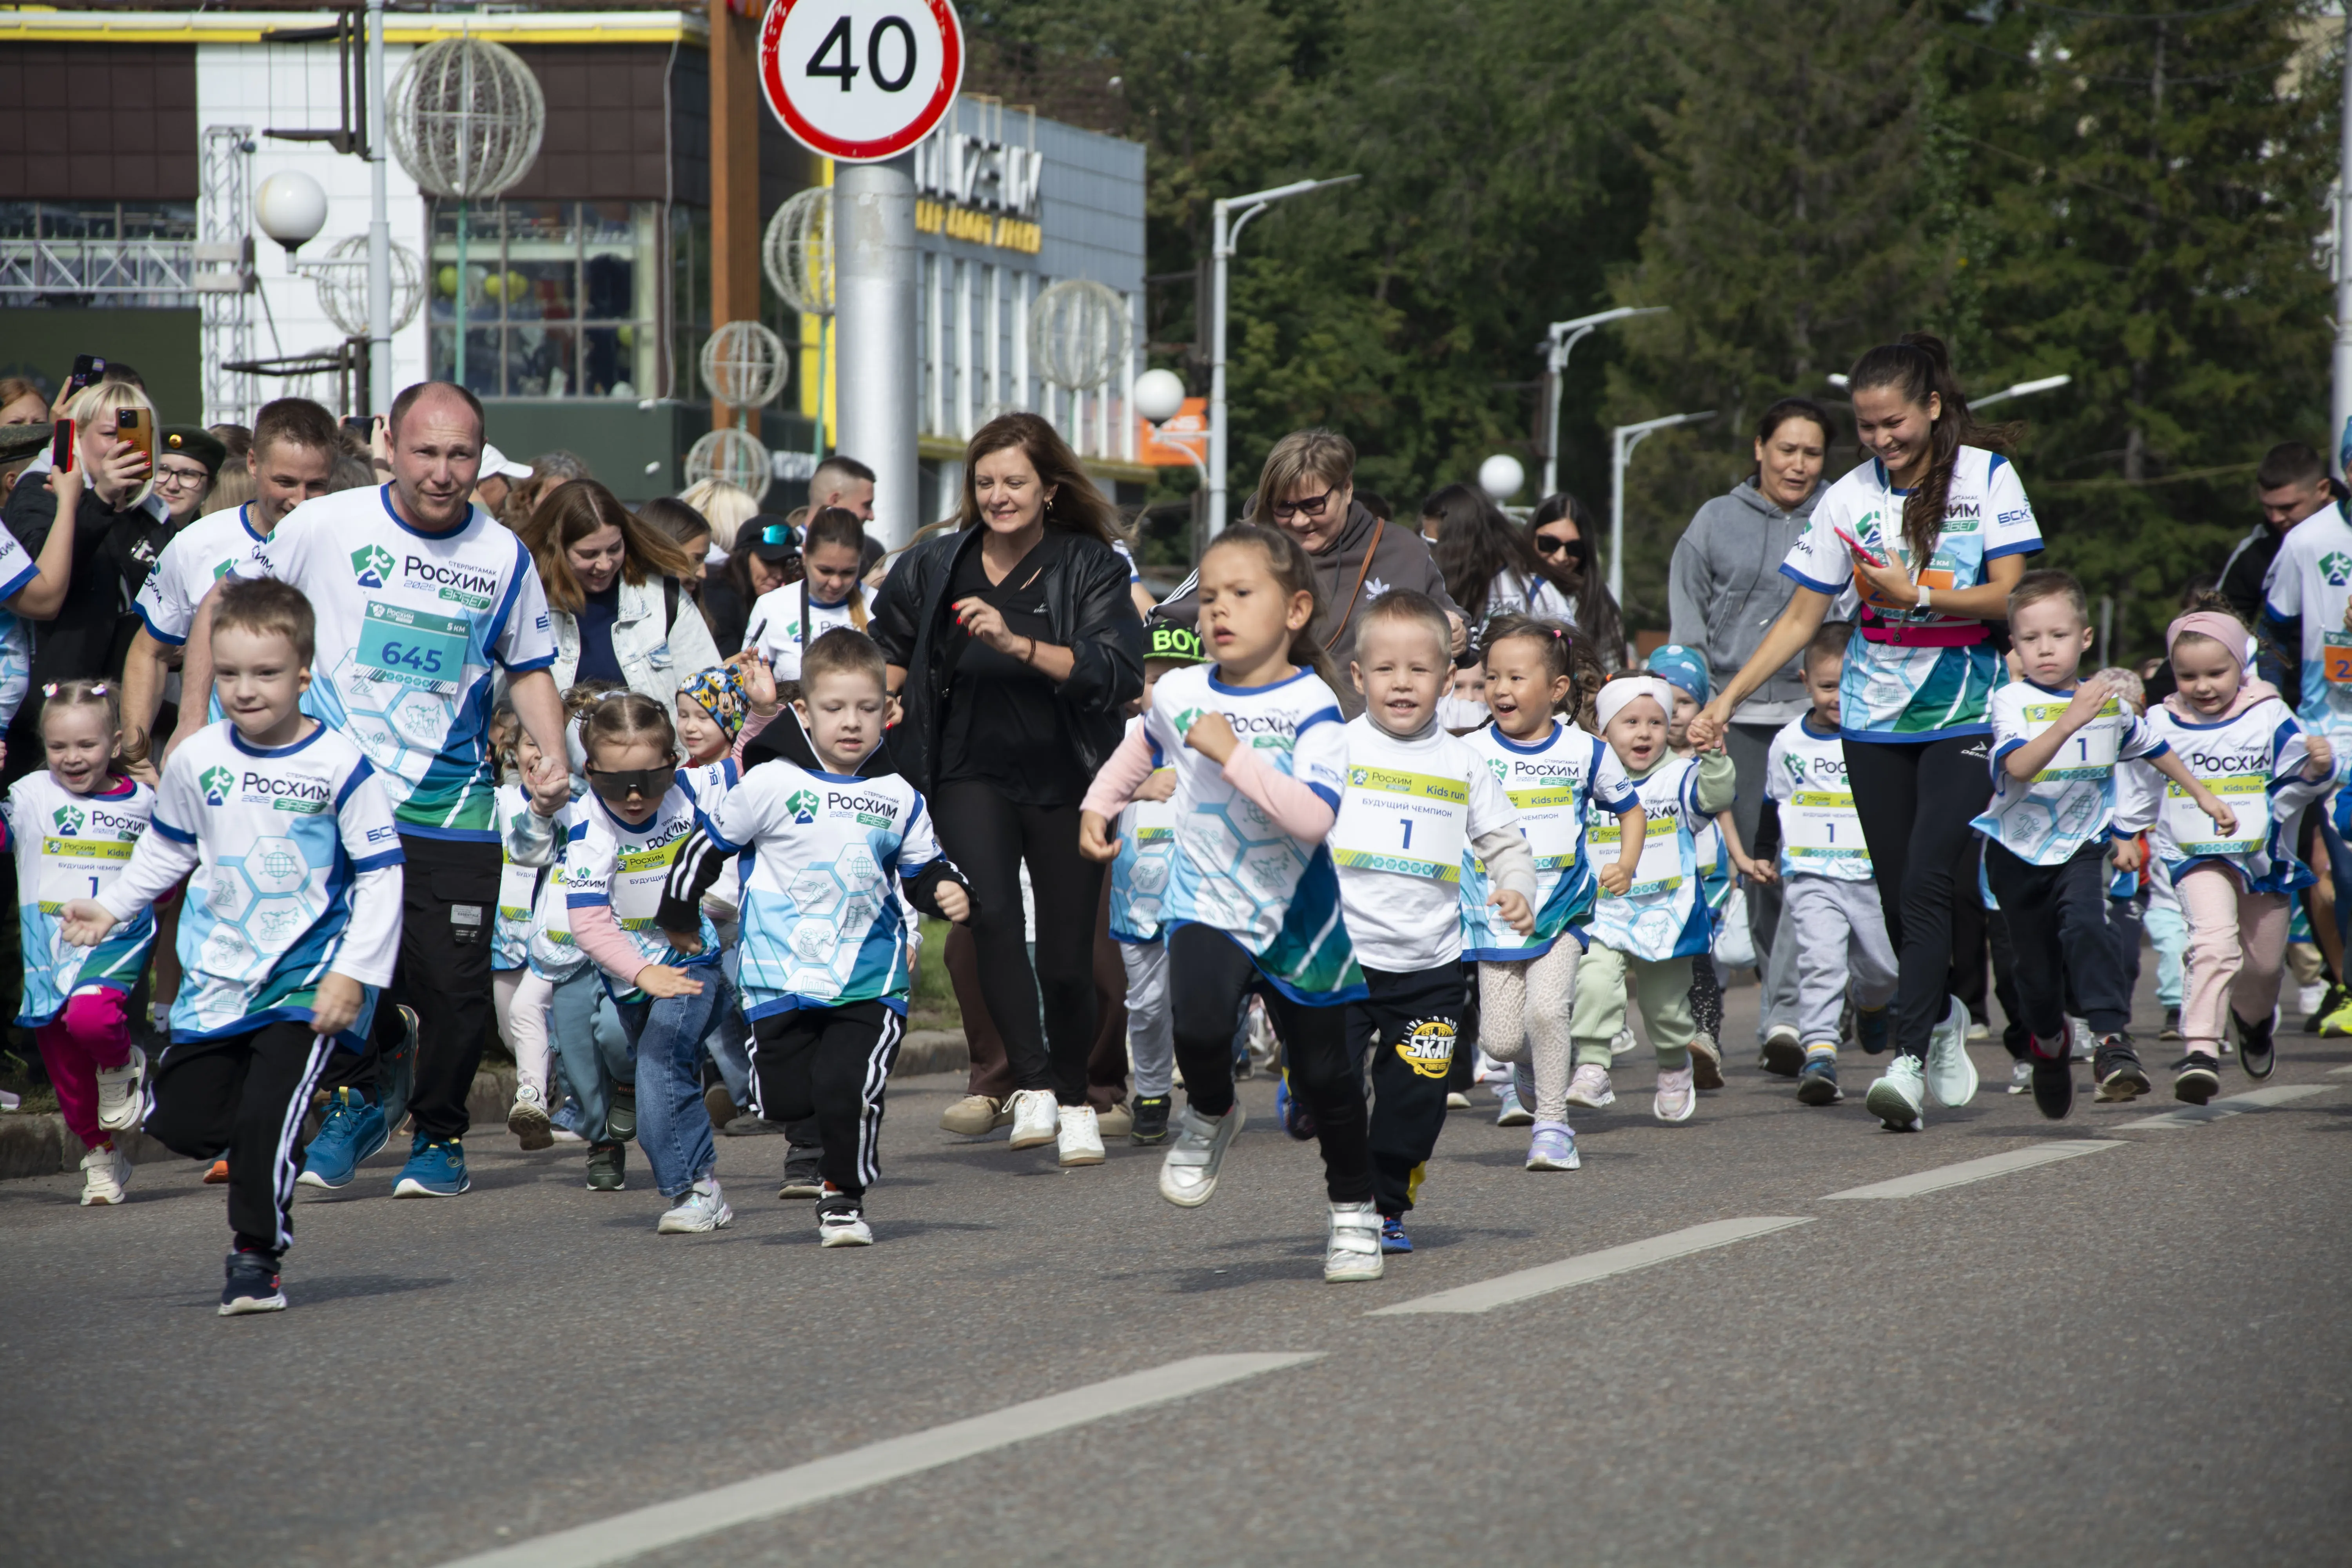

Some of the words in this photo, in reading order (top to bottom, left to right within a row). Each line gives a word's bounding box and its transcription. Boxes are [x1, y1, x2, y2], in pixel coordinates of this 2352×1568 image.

[806, 15, 917, 93] 40
[1997, 508, 2031, 524] БСК
[1942, 521, 1978, 532] АБЕГ
[1793, 539, 1814, 557] ХИМ
[448, 560, 497, 576] СТЕРЛИТАМАК
[404, 580, 437, 592] 2025
[442, 588, 489, 608] ЗАБЕГ
[446, 622, 453, 631] 5
[1152, 628, 1201, 657] BOY
[381, 641, 443, 673] 645
[2336, 660, 2352, 678] 2
[2076, 738, 2087, 761] 1
[1814, 757, 1847, 774] Рос
[1426, 785, 1448, 797] Kids
[1451, 791, 1465, 800] run
[1615, 776, 1630, 792] БС
[241, 795, 271, 804] 2025
[277, 799, 319, 813] ЗАБЕ
[864, 790, 900, 805] СТЕРЛИТАМАК
[1362, 798, 1409, 811] БУДУЩИЙ
[1412, 805, 1452, 818] ЧЕМПИОН
[1400, 818, 1413, 849] 1
[1646, 827, 1656, 835] ds
[1826, 823, 1835, 843] 1
[88, 876, 99, 899] 1
[630, 873, 669, 885] БУДУЩИЙ
[1403, 1018, 1424, 1036] LIVE
